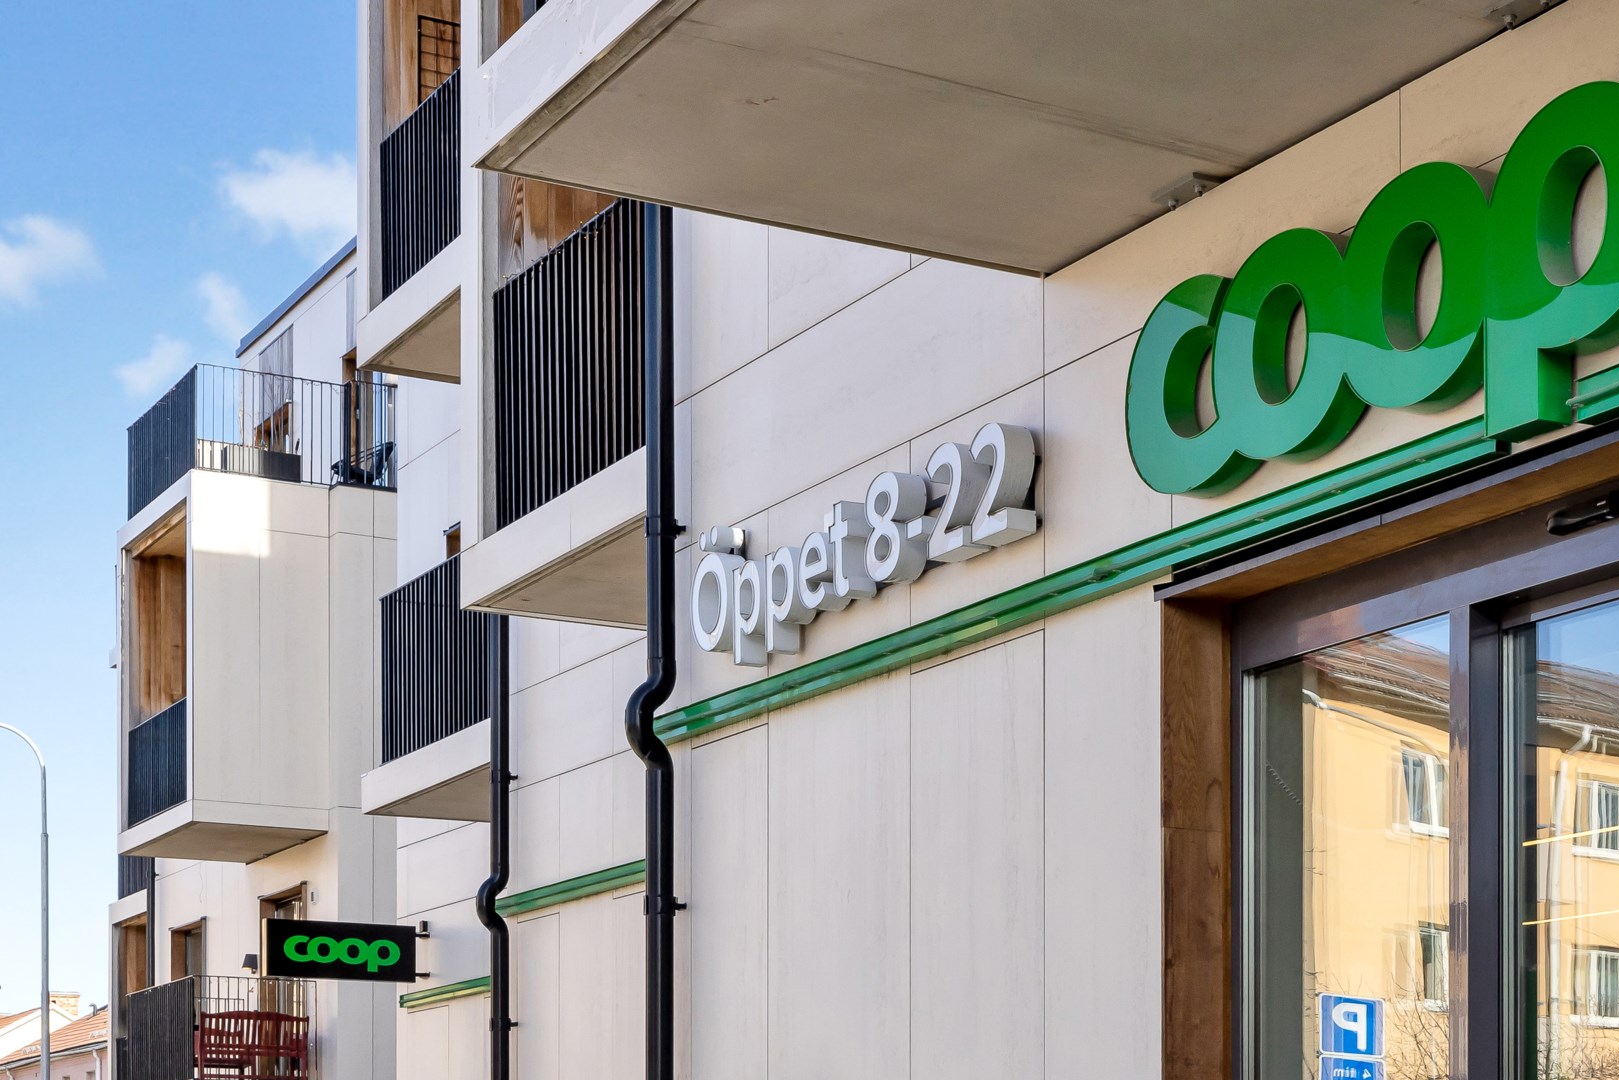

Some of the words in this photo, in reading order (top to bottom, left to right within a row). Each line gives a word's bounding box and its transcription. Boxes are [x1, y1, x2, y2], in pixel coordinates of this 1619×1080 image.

[691, 525, 864, 666] Öppet
[864, 422, 1037, 584] 8-22
[283, 934, 401, 973] coop
